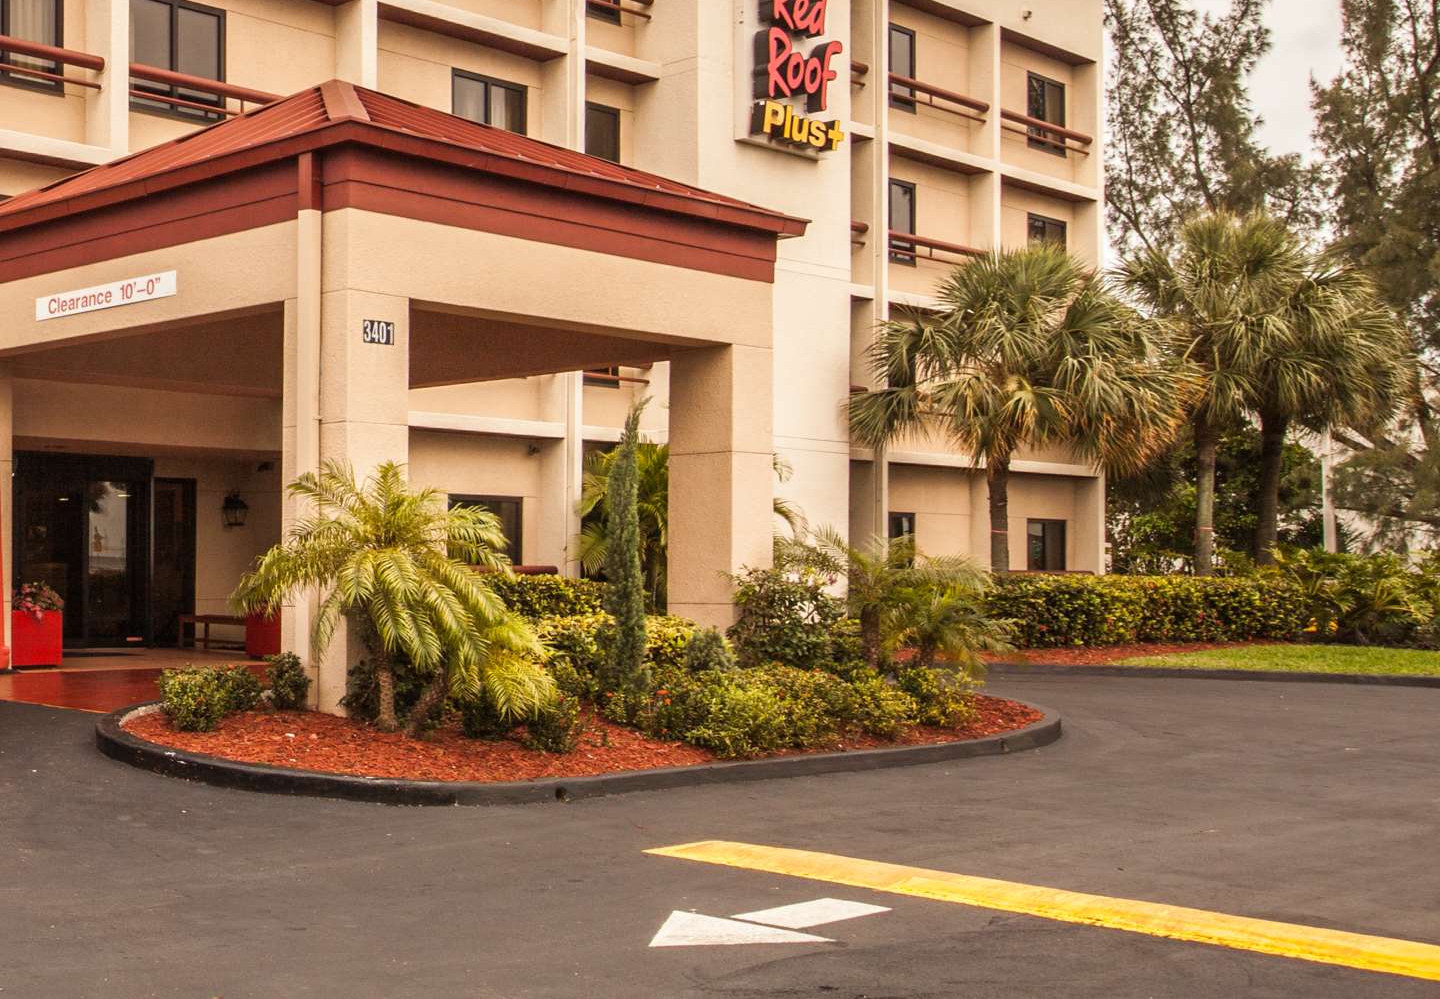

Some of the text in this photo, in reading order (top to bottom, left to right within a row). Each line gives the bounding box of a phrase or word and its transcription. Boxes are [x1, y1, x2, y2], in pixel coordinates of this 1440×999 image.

[768, 26, 843, 111] Roof
[763, 100, 844, 151] Plus+
[48, 290, 112, 314] Clearance
[364, 320, 394, 344] 3401
